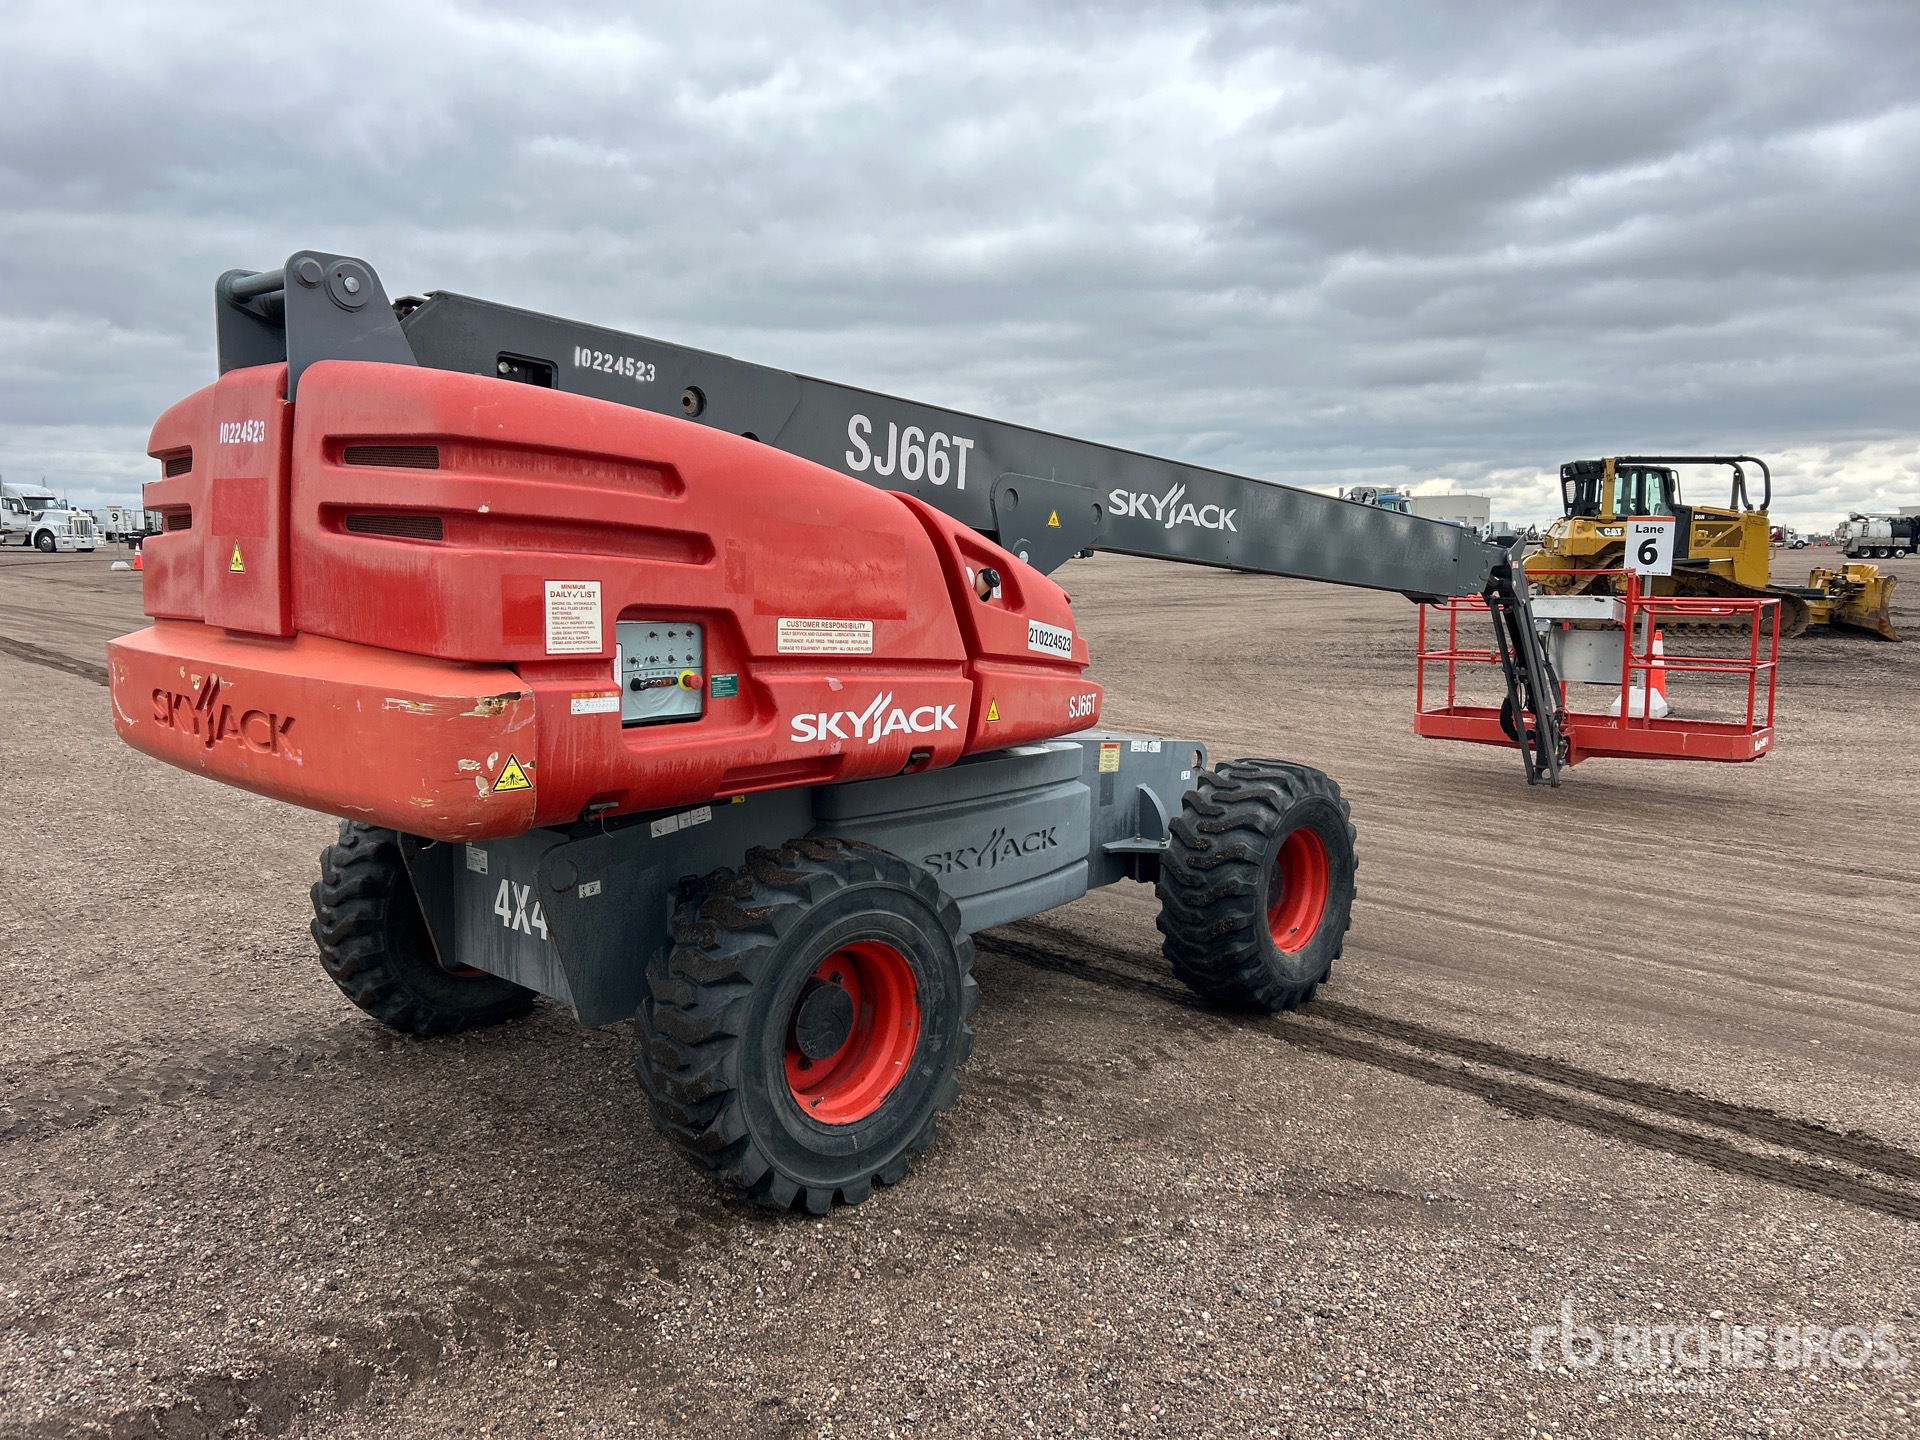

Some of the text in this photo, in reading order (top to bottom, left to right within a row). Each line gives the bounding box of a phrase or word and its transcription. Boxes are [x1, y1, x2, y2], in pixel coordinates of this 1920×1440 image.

[219, 419, 265, 444] 10224523
[845, 414, 974, 490] SJ66T
[111, 512, 119, 522] 9
[1108, 482, 1237, 532] SKYJACK
[1604, 528, 1622, 536] CAT
[1635, 524, 1665, 534] Lane
[1637, 537, 1658, 566] 6
[549, 590, 572, 598] DAILY
[786, 620, 866, 630] CUSTOMER RESPONSIBILITY
[1028, 627, 1071, 652] 210224523
[790, 691, 959, 744] SKYJACK
[1069, 692, 1097, 718] SJ66T
[152, 673, 303, 766] SKYJACK
[921, 826, 1058, 876] SKYJACK
[494, 878, 549, 941] 4X4
